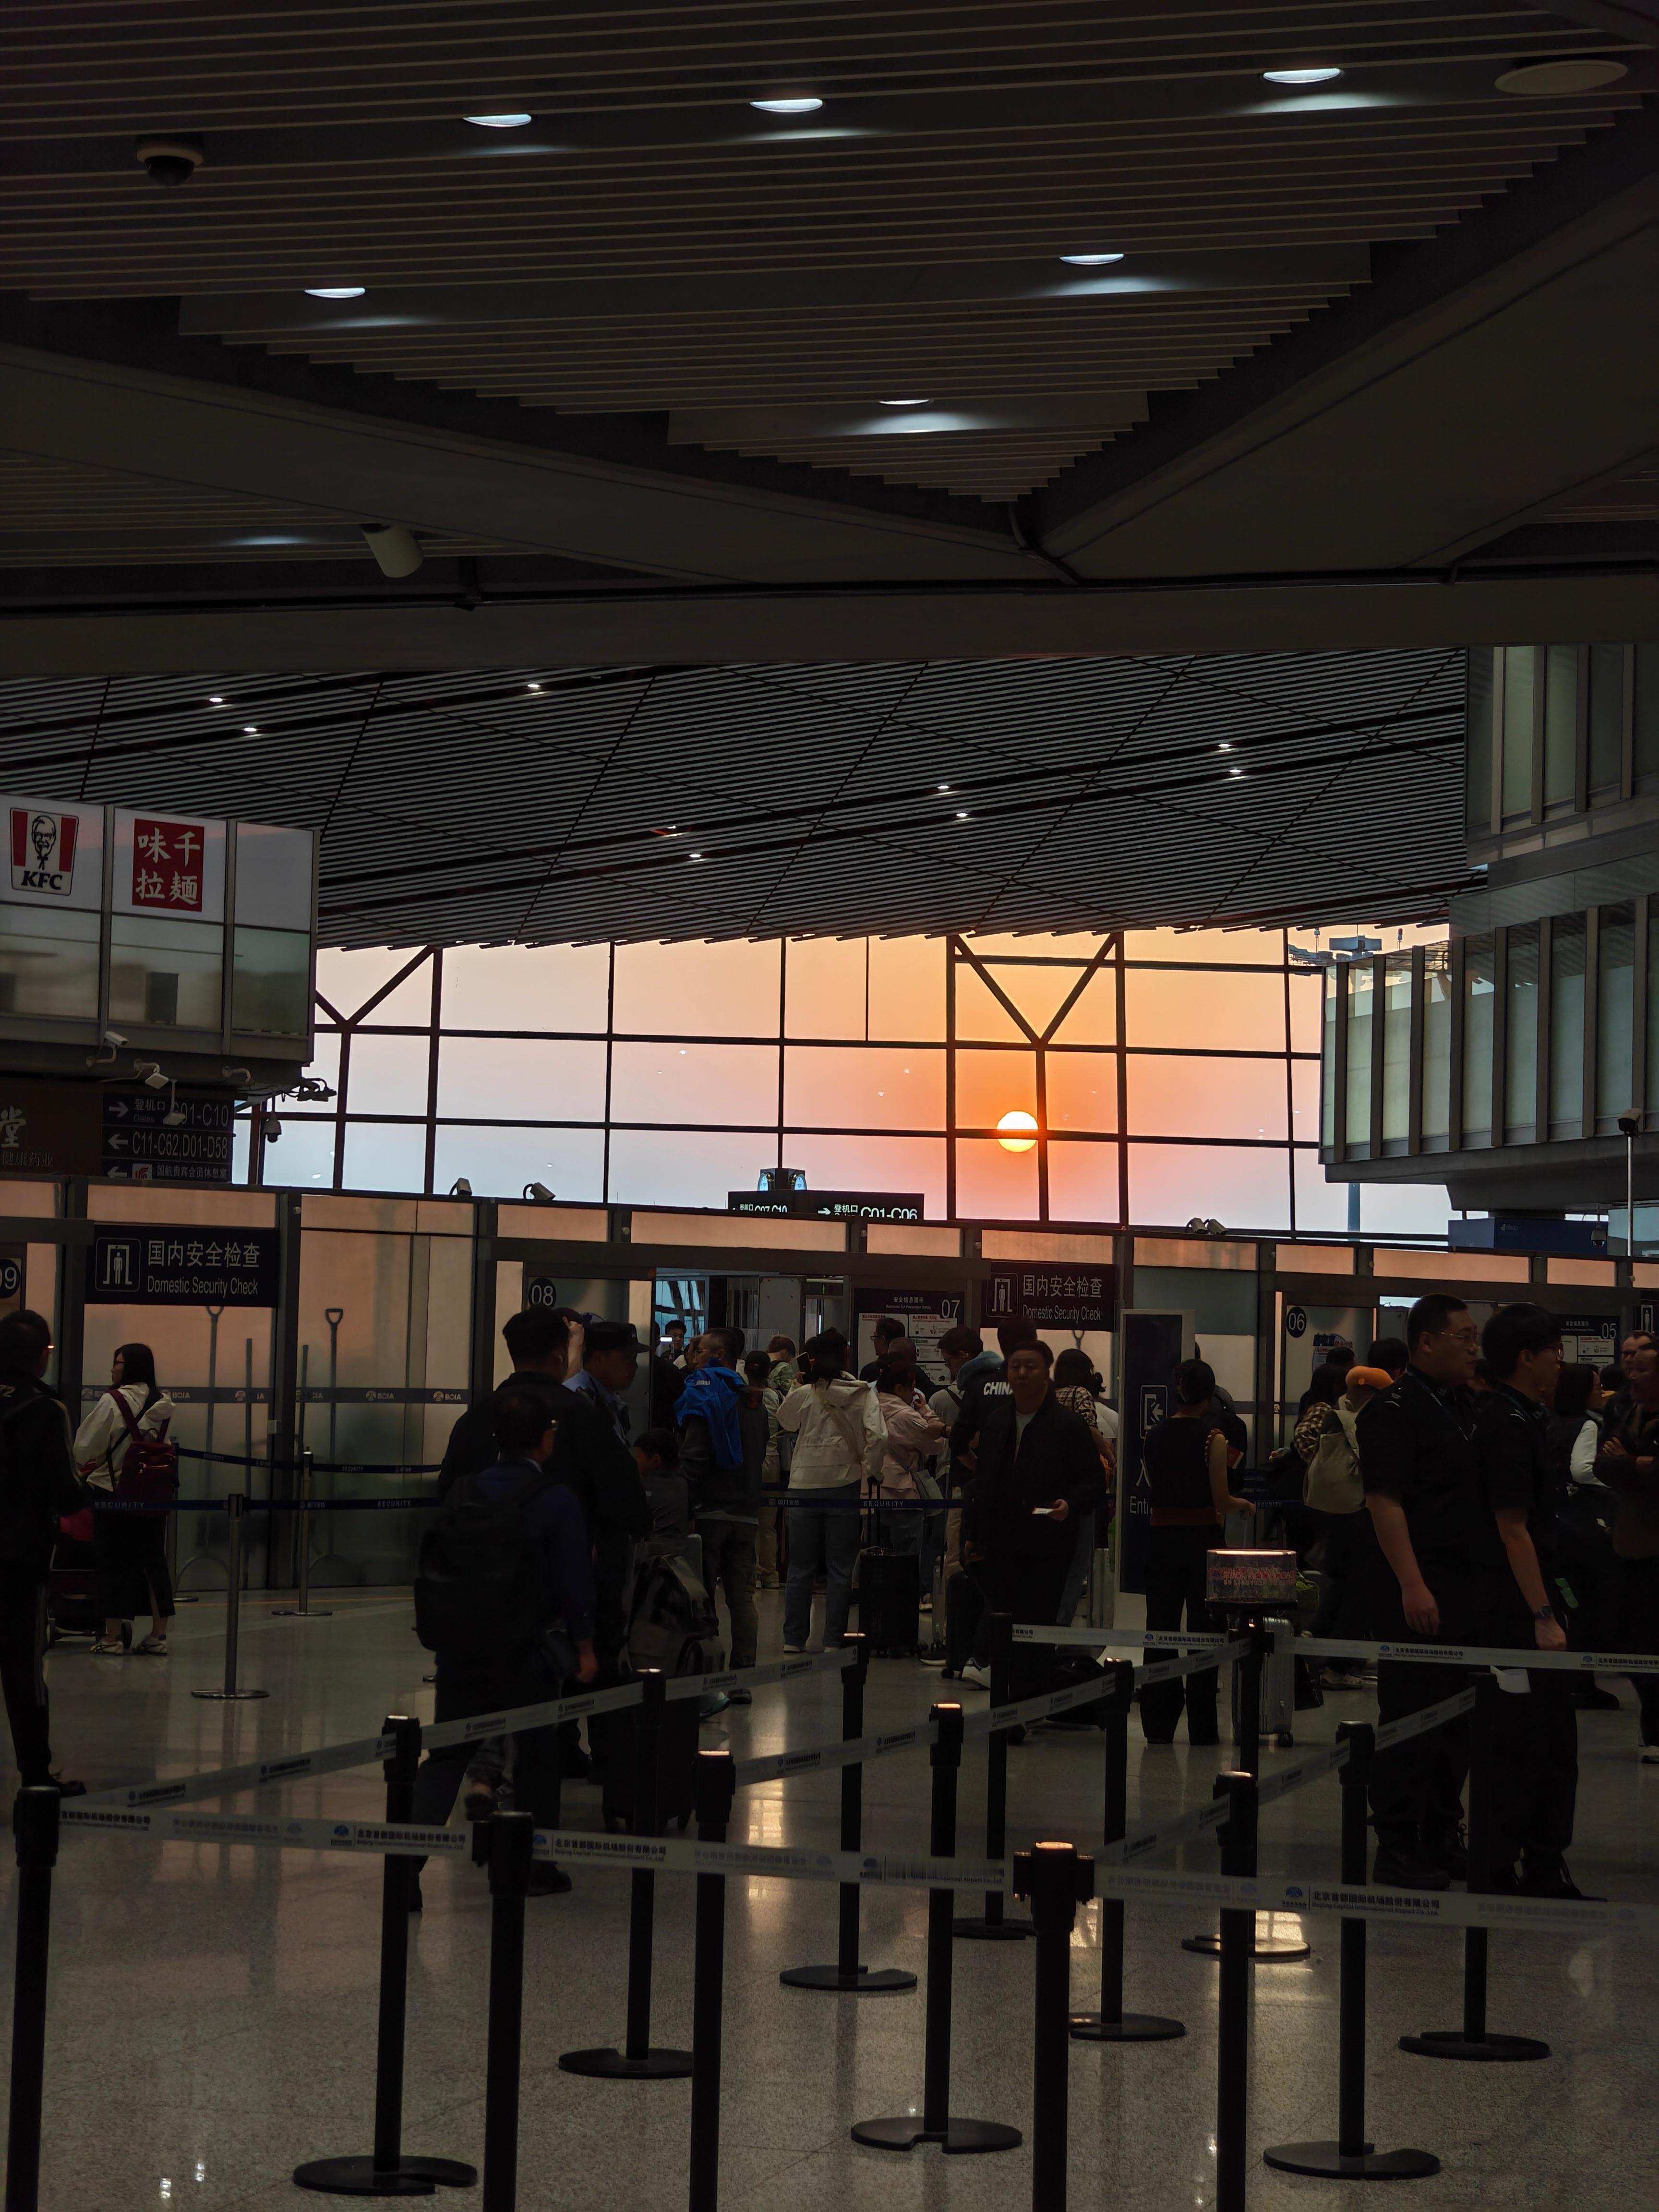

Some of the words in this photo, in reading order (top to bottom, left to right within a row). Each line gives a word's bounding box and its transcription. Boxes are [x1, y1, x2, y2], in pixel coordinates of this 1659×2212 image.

[137, 827, 201, 867] 味千
[21, 871, 62, 890] KFC
[134, 1098, 165, 1112] 登机口
[171, 1102, 228, 1127] 01-C10
[0, 1105, 27, 1148] 堂
[132, 1131, 228, 1159] C11-C62,D01-D58
[740, 1203, 754, 1212] 登机口
[834, 1204, 858, 1213] 登机口
[860, 1206, 918, 1220] C01-C06
[147, 1240, 261, 1268] 国内安全检查
[0, 1266, 17, 1290] 9
[147, 1275, 190, 1295] Domestic
[192, 1277, 228, 1298] Security
[230, 1281, 258, 1295] Check
[1022, 1274, 1103, 1298] 国内安全检查
[530, 1285, 554, 1306] 08
[941, 1299, 961, 1319] 07
[1022, 1304, 1053, 1320] Domestic
[1054, 1305, 1080, 1325] Security
[1081, 1306, 1101, 1322] Check
[1288, 1312, 1305, 1330] 06
[1601, 1322, 1617, 1339] 05
[1135, 1458, 1151, 1487] 入
[1314, 1890, 1440, 1909] 北京首都国际机场股份有限公司
